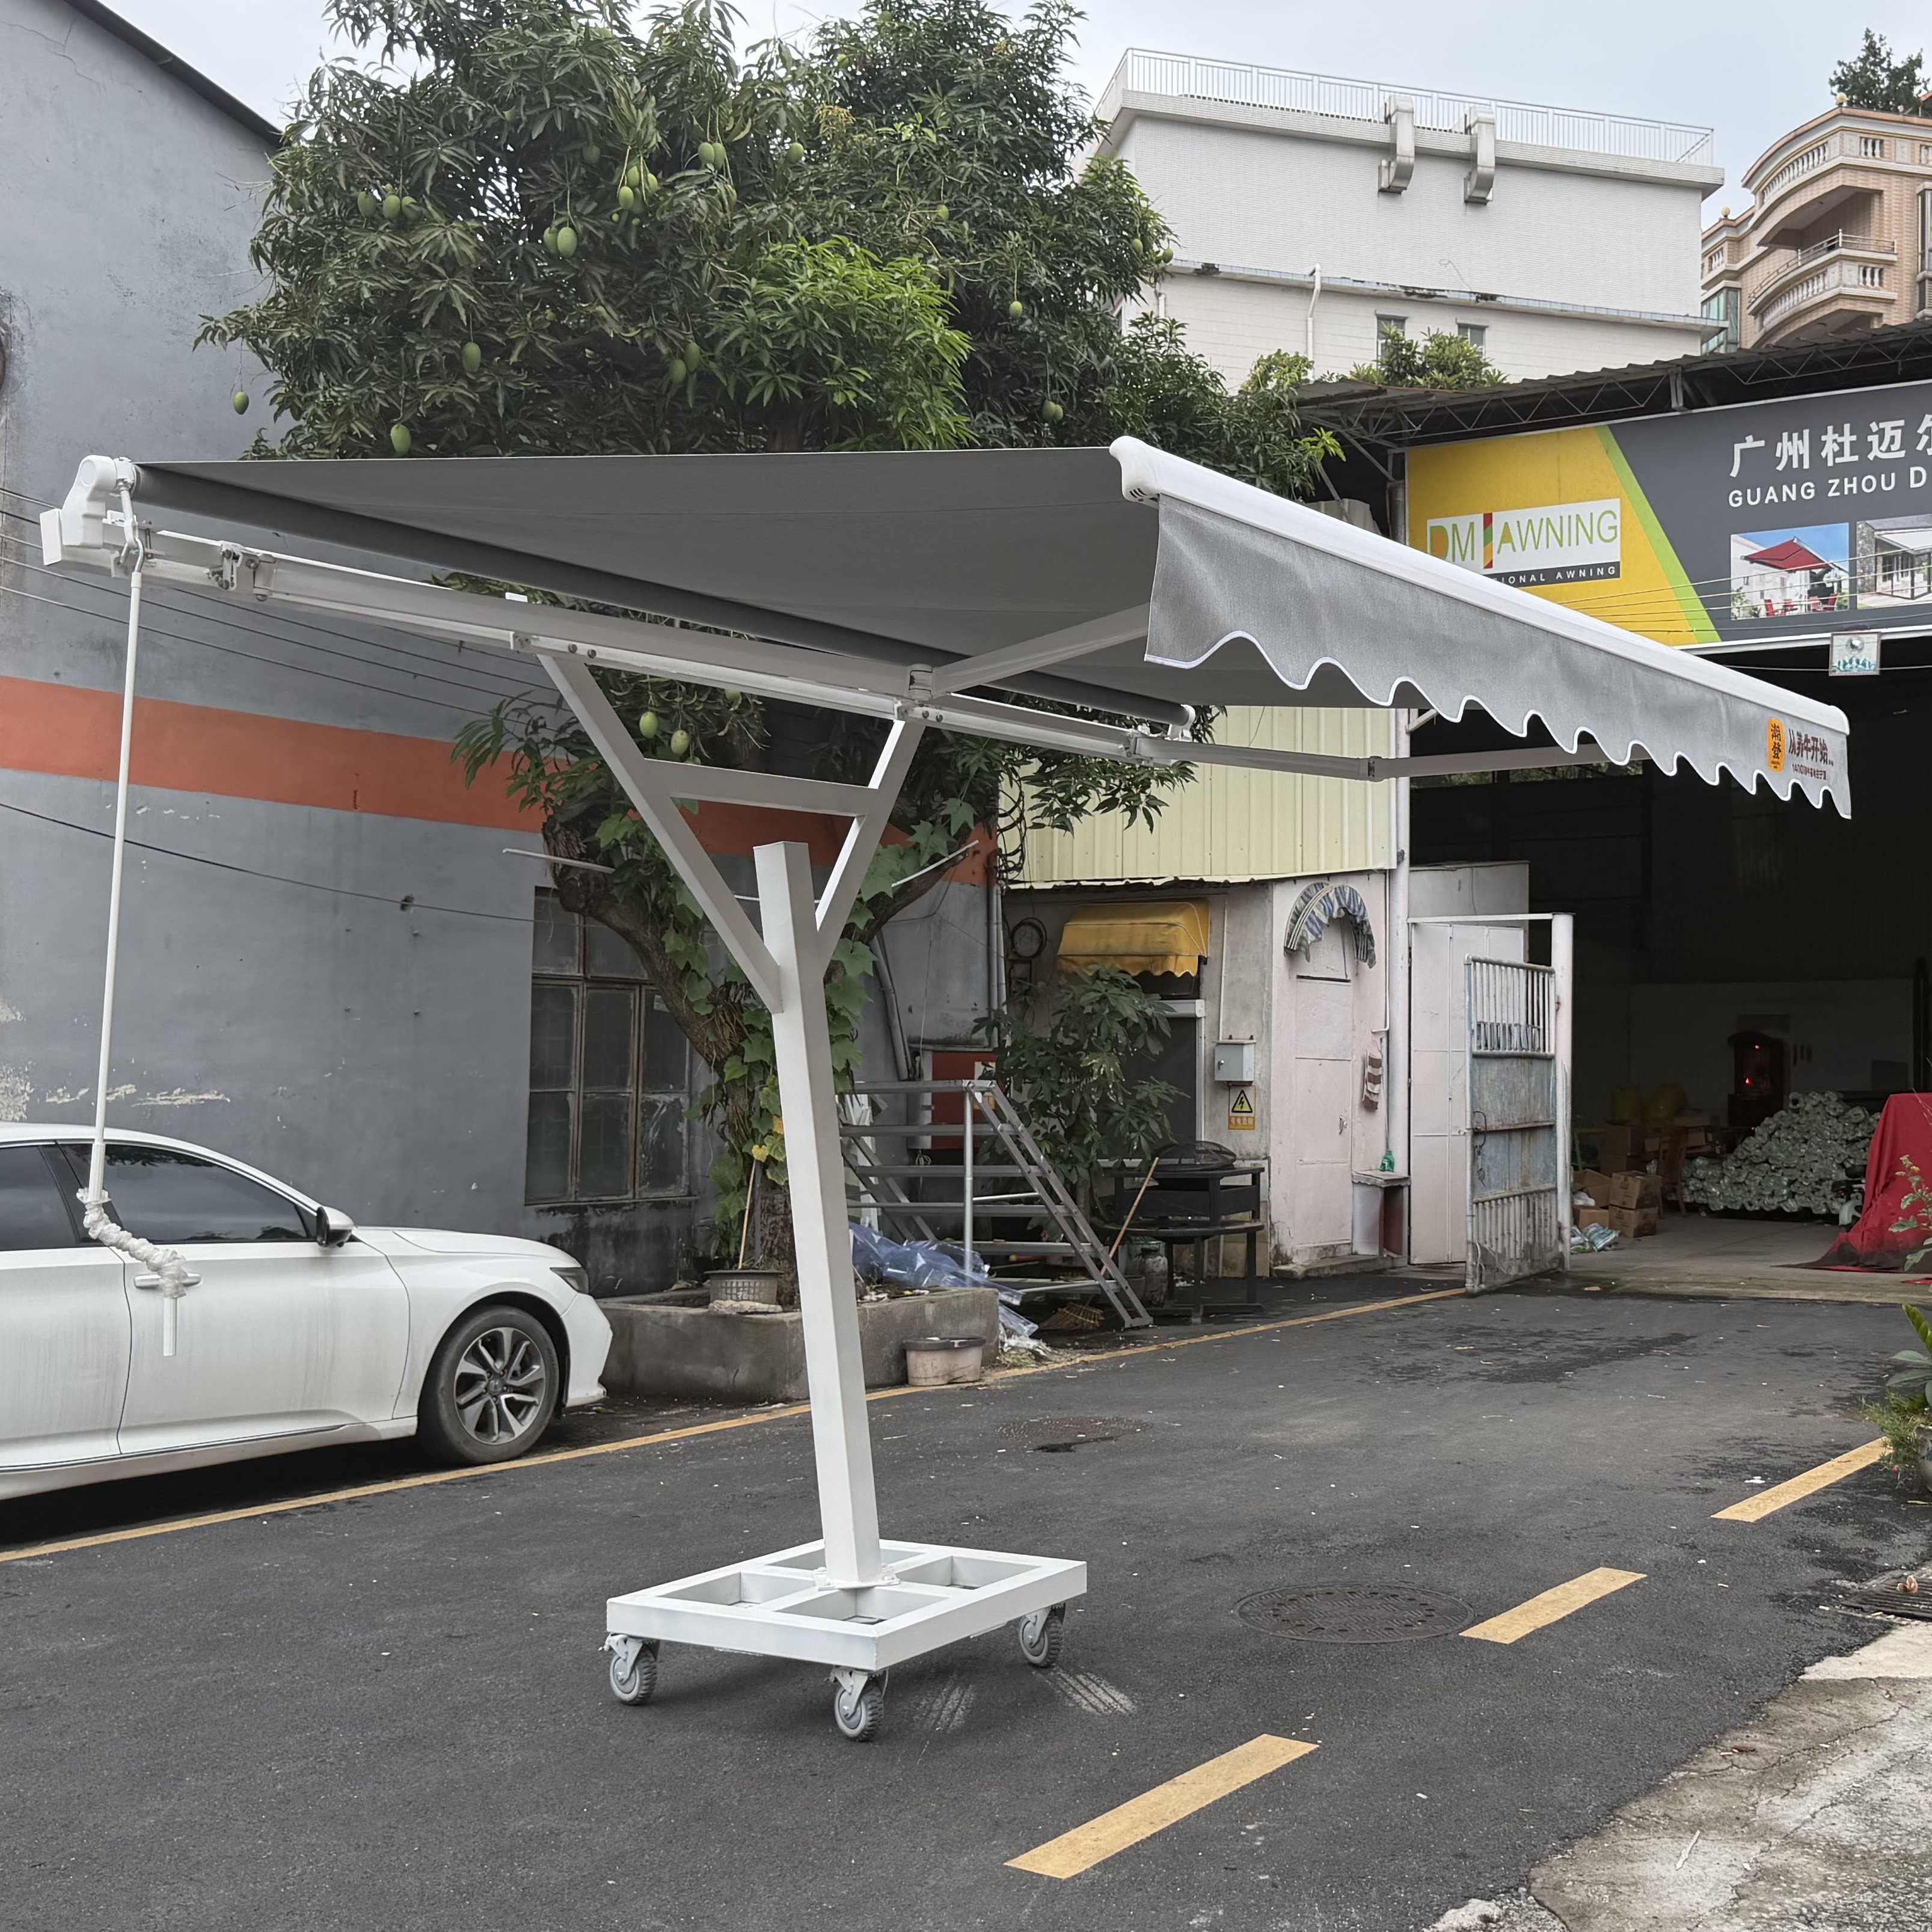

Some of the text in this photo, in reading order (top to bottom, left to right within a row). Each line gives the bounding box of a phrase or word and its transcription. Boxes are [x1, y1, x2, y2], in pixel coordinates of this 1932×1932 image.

[1728, 482, 1815, 508] GUANG
[1827, 473, 1895, 497] ZHOU
[1429, 509, 1618, 562] DM AWNING
[1493, 566, 1616, 584] IONAL AWNING
